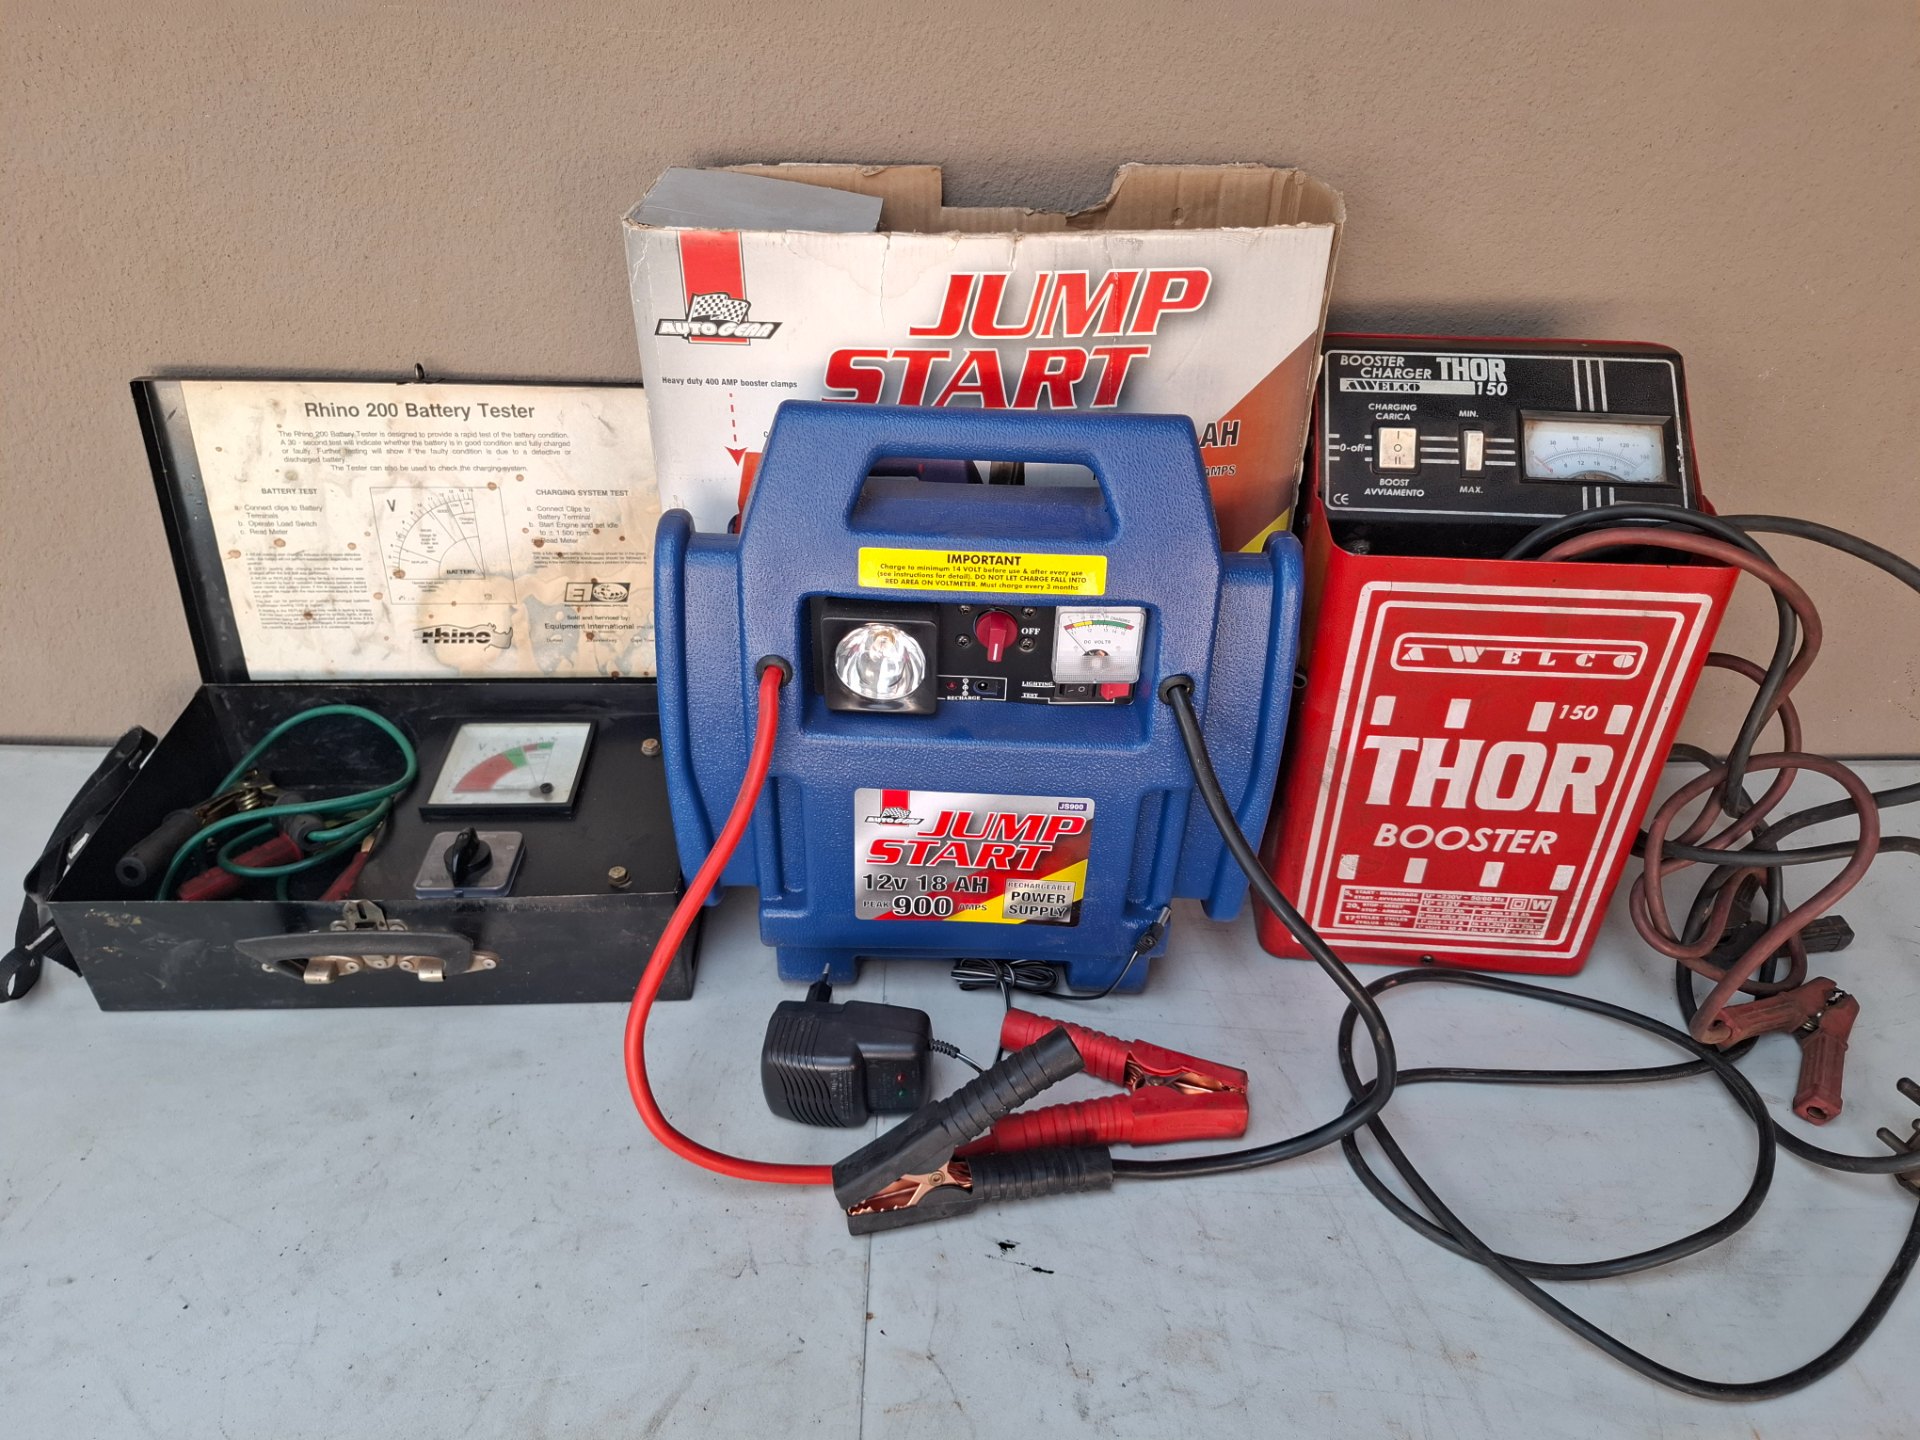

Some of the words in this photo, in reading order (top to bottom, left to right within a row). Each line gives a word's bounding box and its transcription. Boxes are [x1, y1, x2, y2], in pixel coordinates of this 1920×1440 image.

[909, 268, 1212, 338] JUMP
[1339, 354, 1405, 369] BOOSTER
[822, 344, 1151, 410] START
[1360, 366, 1432, 381] CHARGER
[1435, 356, 1507, 383] THOR
[662, 376, 685, 386] Heavy
[687, 378, 704, 388] duty
[705, 378, 720, 387] 400
[721, 378, 738, 387] AMP
[740, 378, 769, 388] booster
[770, 379, 798, 390] clamps
[1475, 381, 1509, 397] 150
[304, 402, 360, 419] Rhino
[366, 402, 399, 420] 200
[405, 402, 471, 422] Battery
[477, 403, 536, 420] Tester
[1368, 402, 1418, 413] CHARGING
[1458, 410, 1479, 419] MIN.
[1375, 412, 1411, 422] CARICA
[330, 431, 354, 439] Battery
[1199, 420, 1241, 448] AH
[543, 441, 571, 449] charged
[1379, 478, 1410, 488] BOOST
[1459, 486, 1484, 495] MAX.
[1364, 487, 1425, 499] AVVIAMENTO
[386, 499, 396, 513] V
[947, 553, 1022, 567] IMPORTANT
[880, 563, 906, 571] Charge
[916, 564, 950, 572] minimum
[963, 565, 982, 573] VOLT
[893, 571, 934, 579] instructions
[935, 580, 979, 588] VOLTMETER.
[999, 582, 1024, 590] charge
[544, 622, 585, 631] Equipment
[587, 623, 635, 631] International
[1021, 627, 1041, 637] OFF
[421, 627, 492, 645] rhino
[1400, 643, 1637, 670] AWELCO
[1558, 703, 1599, 722] 150
[1362, 735, 1614, 815] THOR
[1058, 802, 1085, 811] JS900
[916, 810, 1087, 843] JUMP
[1373, 822, 1559, 856] BOOSTER
[864, 838, 1053, 871] START
[862, 873, 908, 891] 12v
[916, 874, 948, 891] 18
[952, 875, 989, 893] AH
[1008, 881, 1072, 892] RECHARGEABLE
[1011, 890, 1067, 905] POWER
[862, 900, 890, 909] PEAK
[892, 895, 953, 917] 900
[959, 903, 989, 913] AMPS
[1008, 903, 1069, 919] SUPPLY
